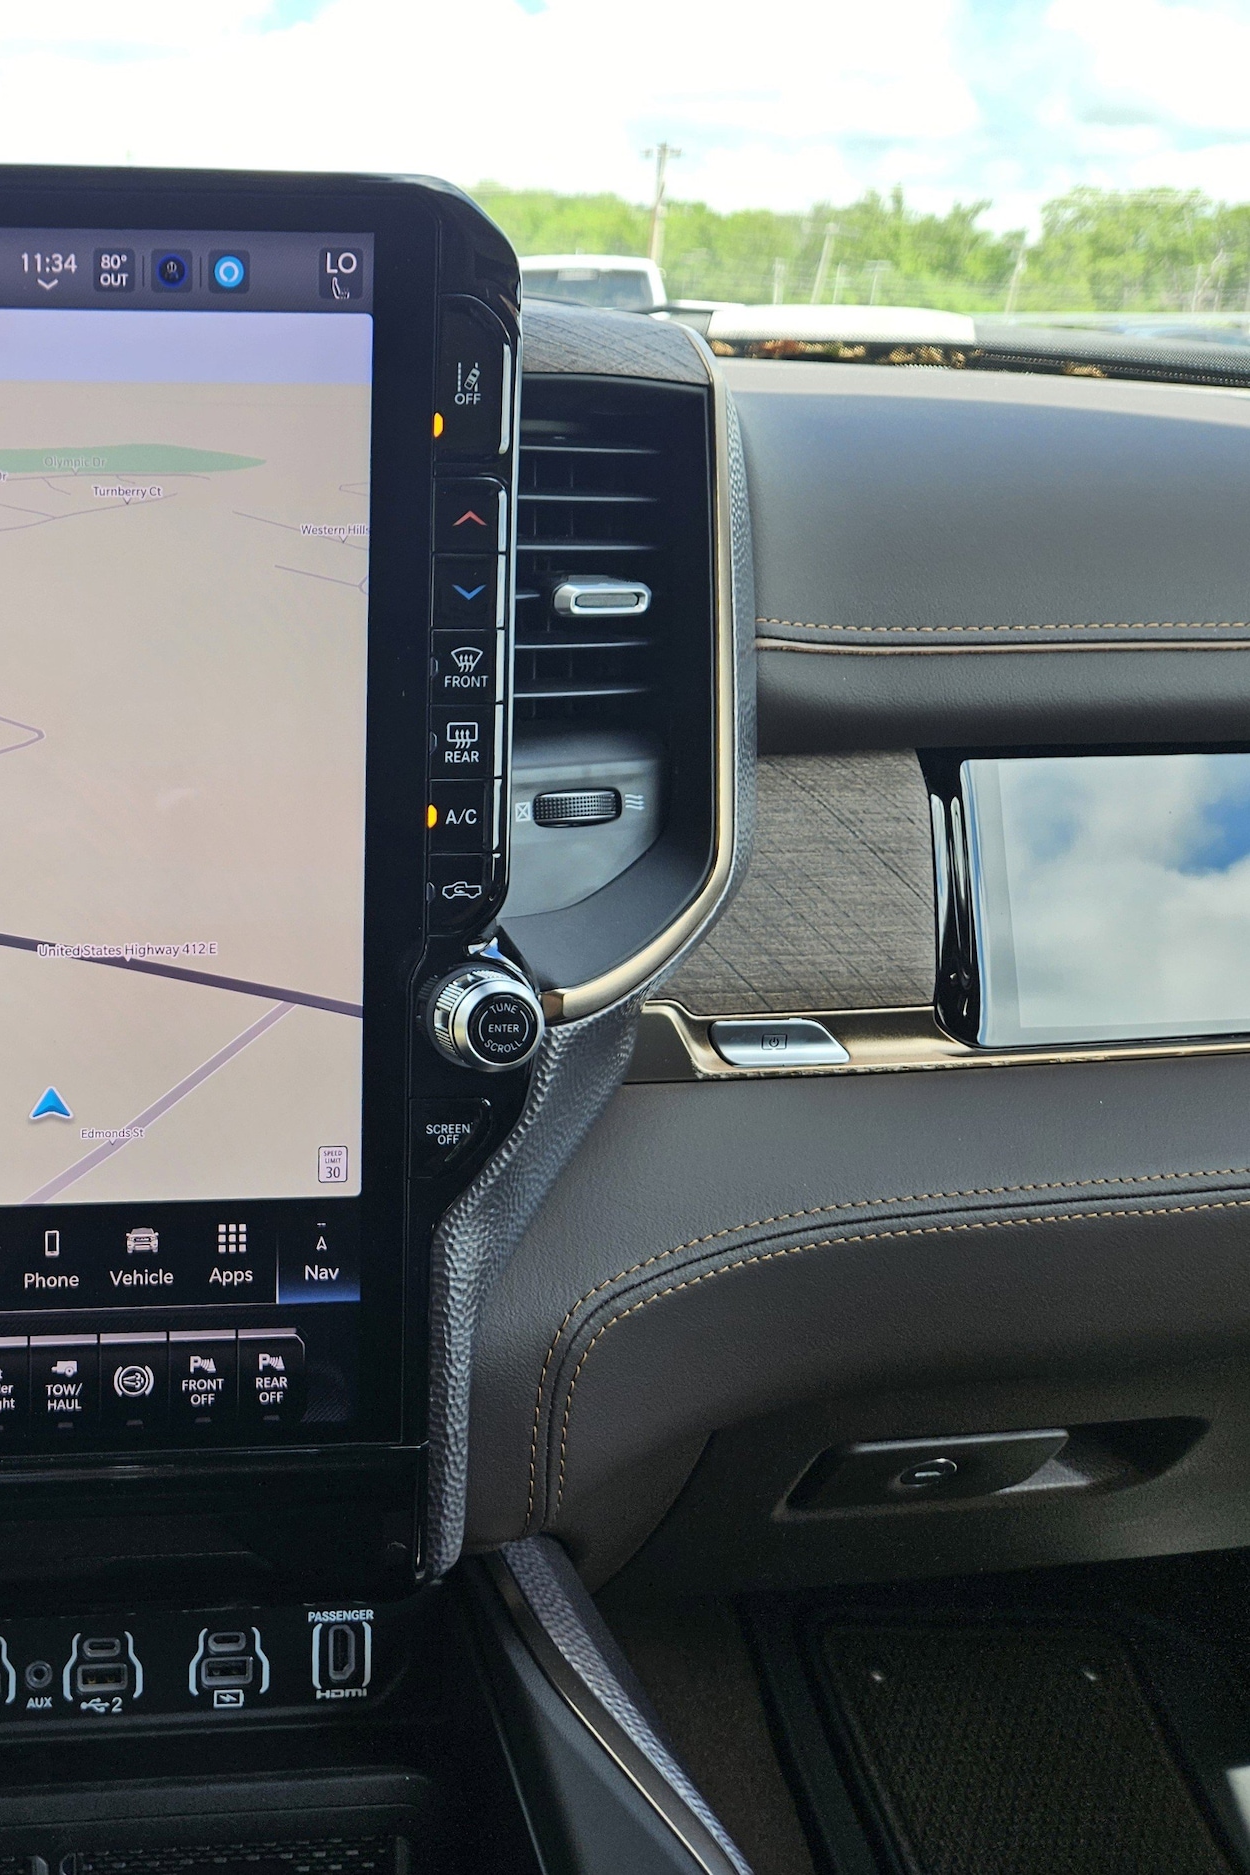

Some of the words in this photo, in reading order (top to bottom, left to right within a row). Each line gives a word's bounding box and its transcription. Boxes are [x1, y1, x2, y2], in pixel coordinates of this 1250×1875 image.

[21, 252, 78, 273] 11:34
[100, 254, 127, 269] 80°
[326, 251, 357, 274] LO
[100, 274, 129, 287] OUT
[454, 393, 481, 405] OFF
[44, 457, 90, 469] Olympic
[92, 457, 106, 468] Dr
[93, 487, 147, 499] Turnberry
[149, 486, 162, 497] Ct
[301, 525, 346, 535] Western
[444, 675, 489, 688] FRONT
[445, 750, 480, 764] REAR
[445, 809, 477, 825] A/C
[39, 944, 80, 957] United
[83, 944, 122, 956] States
[125, 943, 179, 958] Highway
[182, 943, 206, 955] 412
[209, 943, 217, 954] E
[489, 1002, 519, 1015] TUNE
[488, 1023, 520, 1033] ENTER
[483, 1039, 523, 1054] SCROLL
[81, 1128, 131, 1139] Edmonds
[133, 1127, 144, 1138] St
[425, 1123, 471, 1134] SCREEN
[437, 1134, 460, 1145] OFF
[325, 1166, 341, 1179] 30
[109, 1268, 174, 1286] Vehicle
[209, 1266, 254, 1284] Apps
[304, 1264, 340, 1281] Nav
[24, 1271, 80, 1289] Phone
[182, 1378, 225, 1392] FRONT
[255, 1376, 288, 1390] REAR
[45, 1383, 83, 1397] TOW/
[190, 1393, 216, 1406] OFF
[259, 1391, 284, 1404] OFF
[47, 1399, 83, 1412] HAUL
[308, 1609, 375, 1622] PASSENGER
[316, 1688, 368, 1699] HDMI
[27, 1697, 53, 1709] AUX
[111, 1696, 124, 1714] 2
